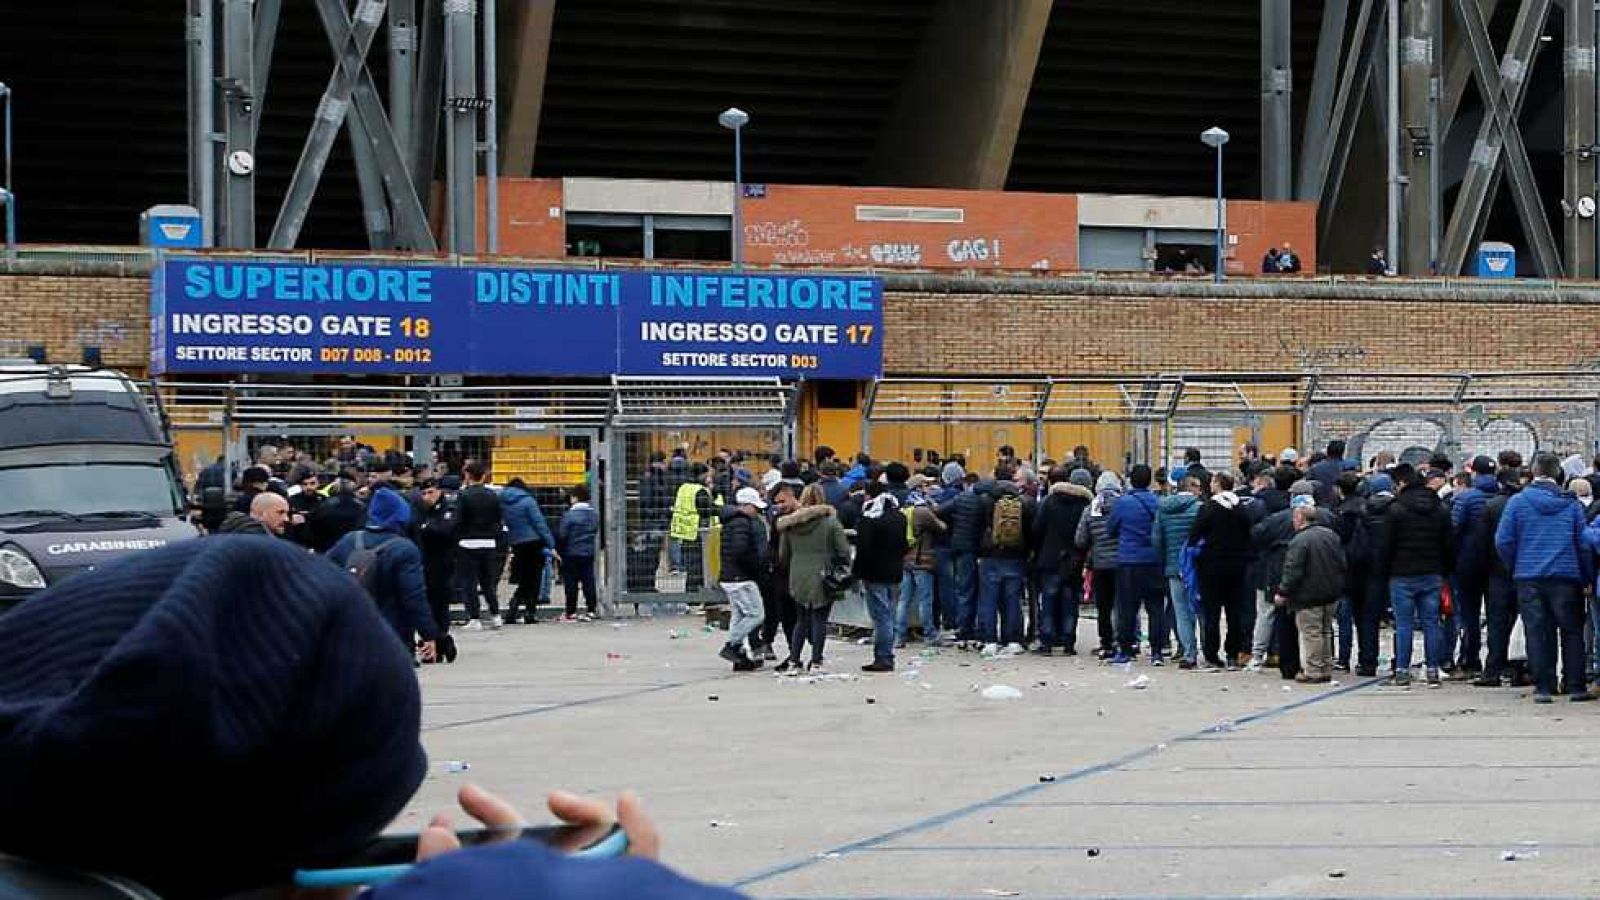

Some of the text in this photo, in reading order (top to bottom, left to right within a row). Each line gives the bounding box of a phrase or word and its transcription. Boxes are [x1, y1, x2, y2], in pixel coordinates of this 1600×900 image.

[184, 264, 433, 304] SUPERIORE
[475, 271, 621, 306] DISTINTI
[650, 274, 875, 312] INFERIORE
[171, 312, 431, 339] INGRESSO GATE 18
[640, 321, 874, 345] INGRESSO GATE 17
[175, 345, 249, 362] SETTORE
[250, 346, 313, 364] SECTOR
[319, 347, 350, 363] D07
[393, 347, 432, 363] D012
[661, 351, 819, 370] SETTORE SECTOR D03
